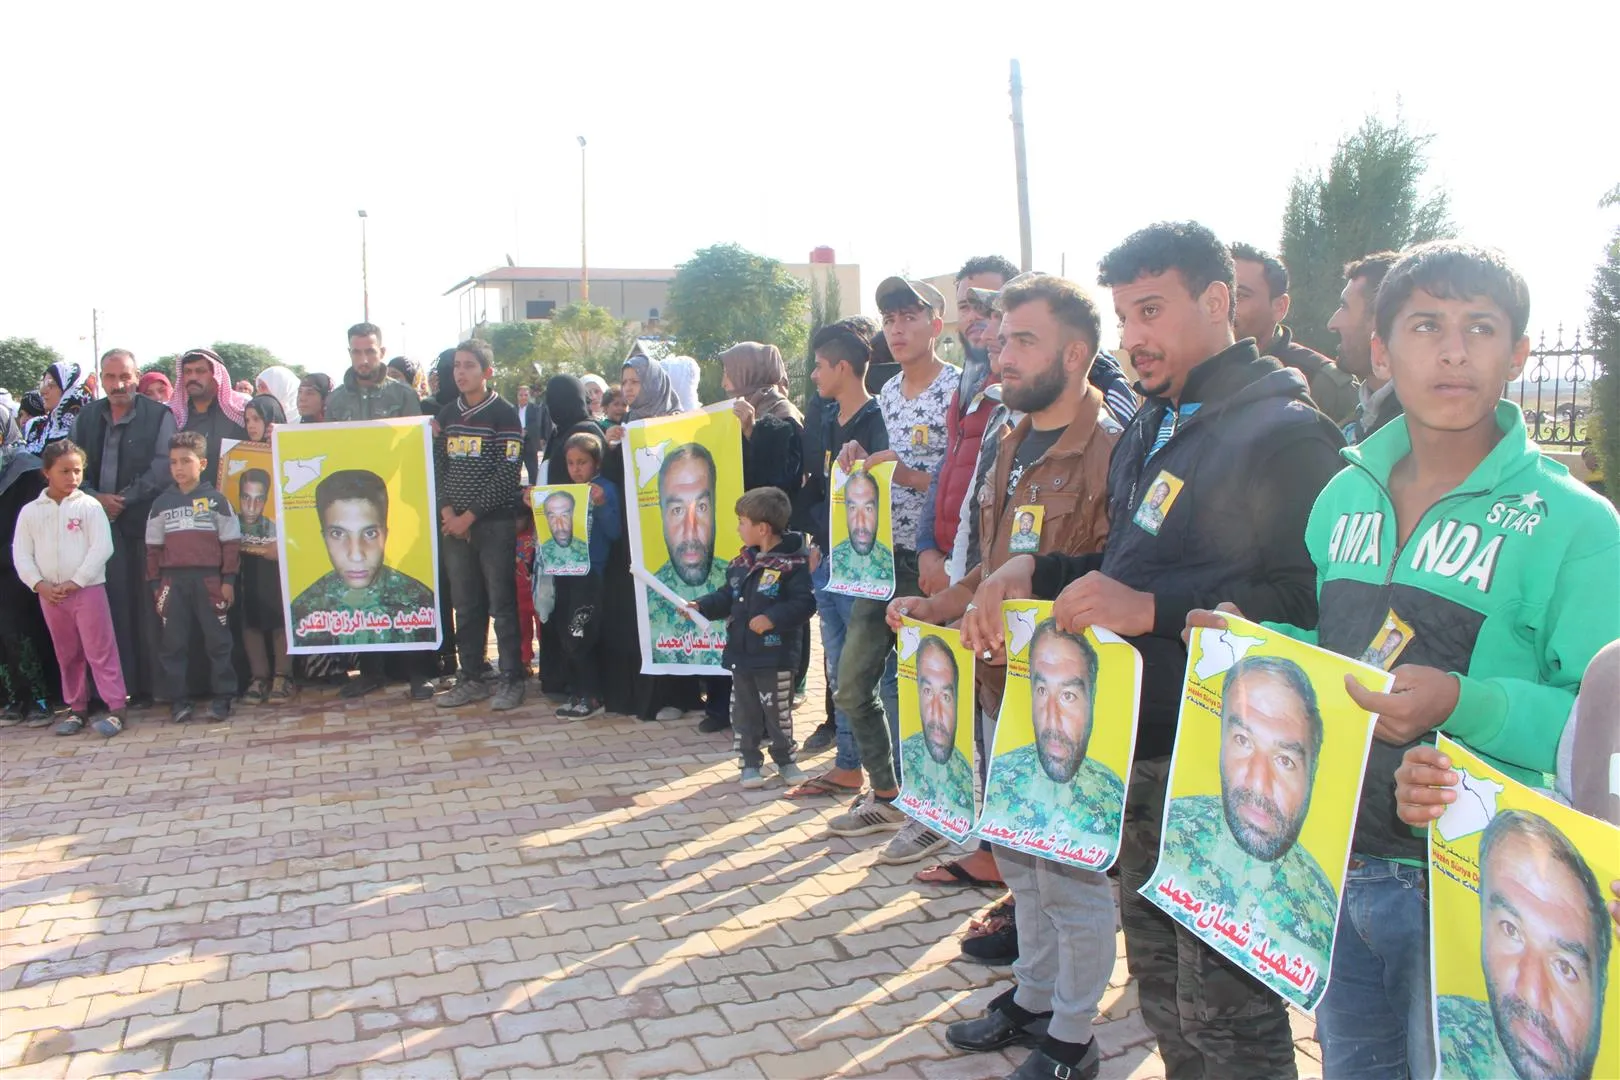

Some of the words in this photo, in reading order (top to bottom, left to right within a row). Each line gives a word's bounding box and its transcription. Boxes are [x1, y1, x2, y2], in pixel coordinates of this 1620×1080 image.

[1486, 502, 1541, 536] STAR
[1328, 511, 1384, 566] AMA
[1410, 518, 1507, 593] NDA
[366, 612, 391, 633] عبد
[394, 607, 435, 633] الشهيد
[656, 632, 684, 650] محمد
[684, 629, 711, 655] شعبان
[981, 820, 1017, 840] محمد
[1010, 829, 1056, 852] شعبان
[1055, 841, 1107, 867] الشهيد
[1157, 877, 1203, 915] محمد
[1196, 903, 1251, 949] شعبان
[1250, 939, 1317, 993] الشهيد
